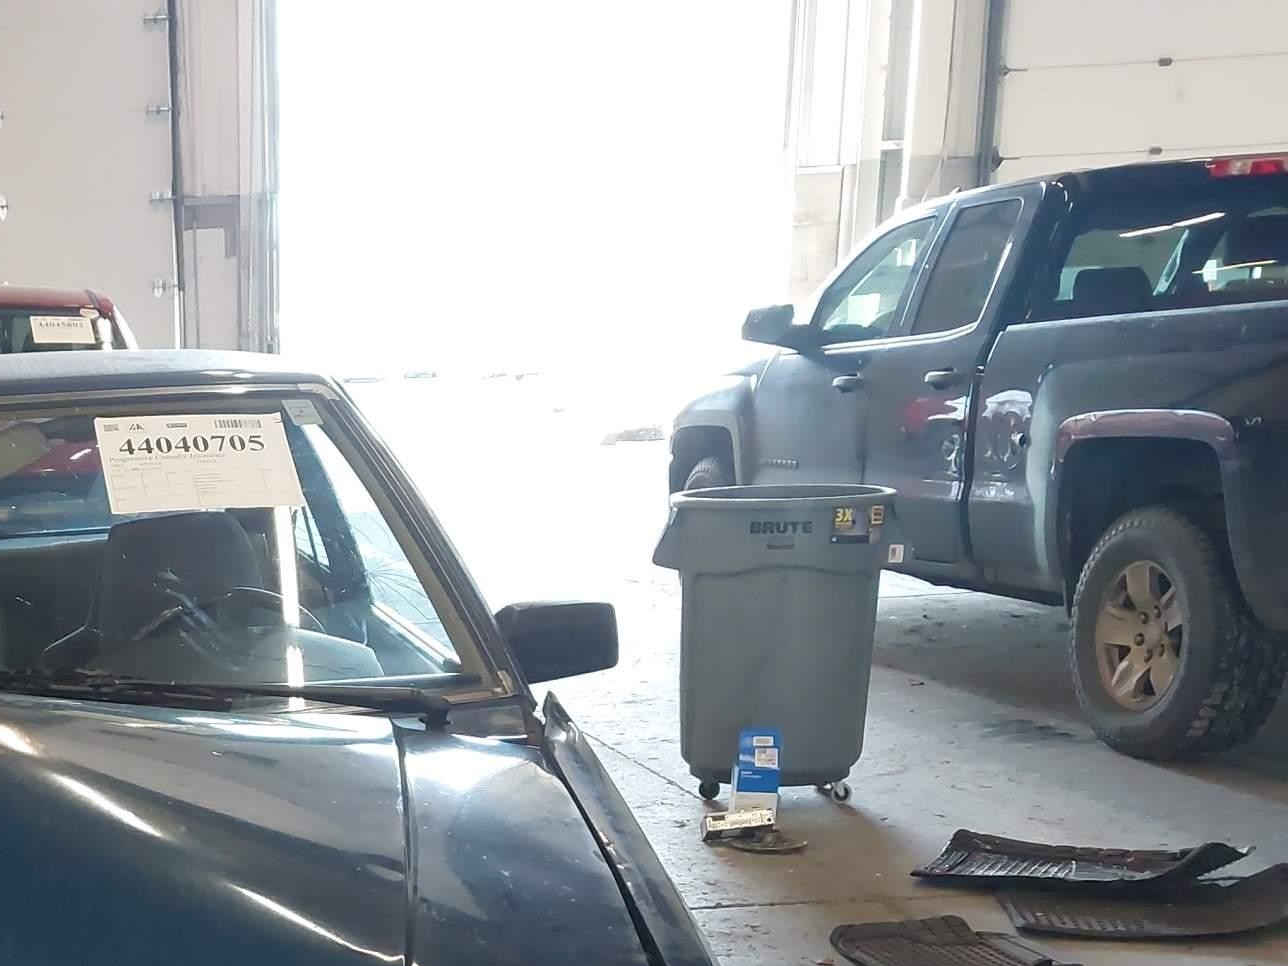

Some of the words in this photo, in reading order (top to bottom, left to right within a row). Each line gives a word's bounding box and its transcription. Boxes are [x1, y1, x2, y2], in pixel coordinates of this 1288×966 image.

[119, 434, 264, 455] 44040705
[835, 508, 853, 521] 3X
[750, 521, 813, 534] BRUTE
